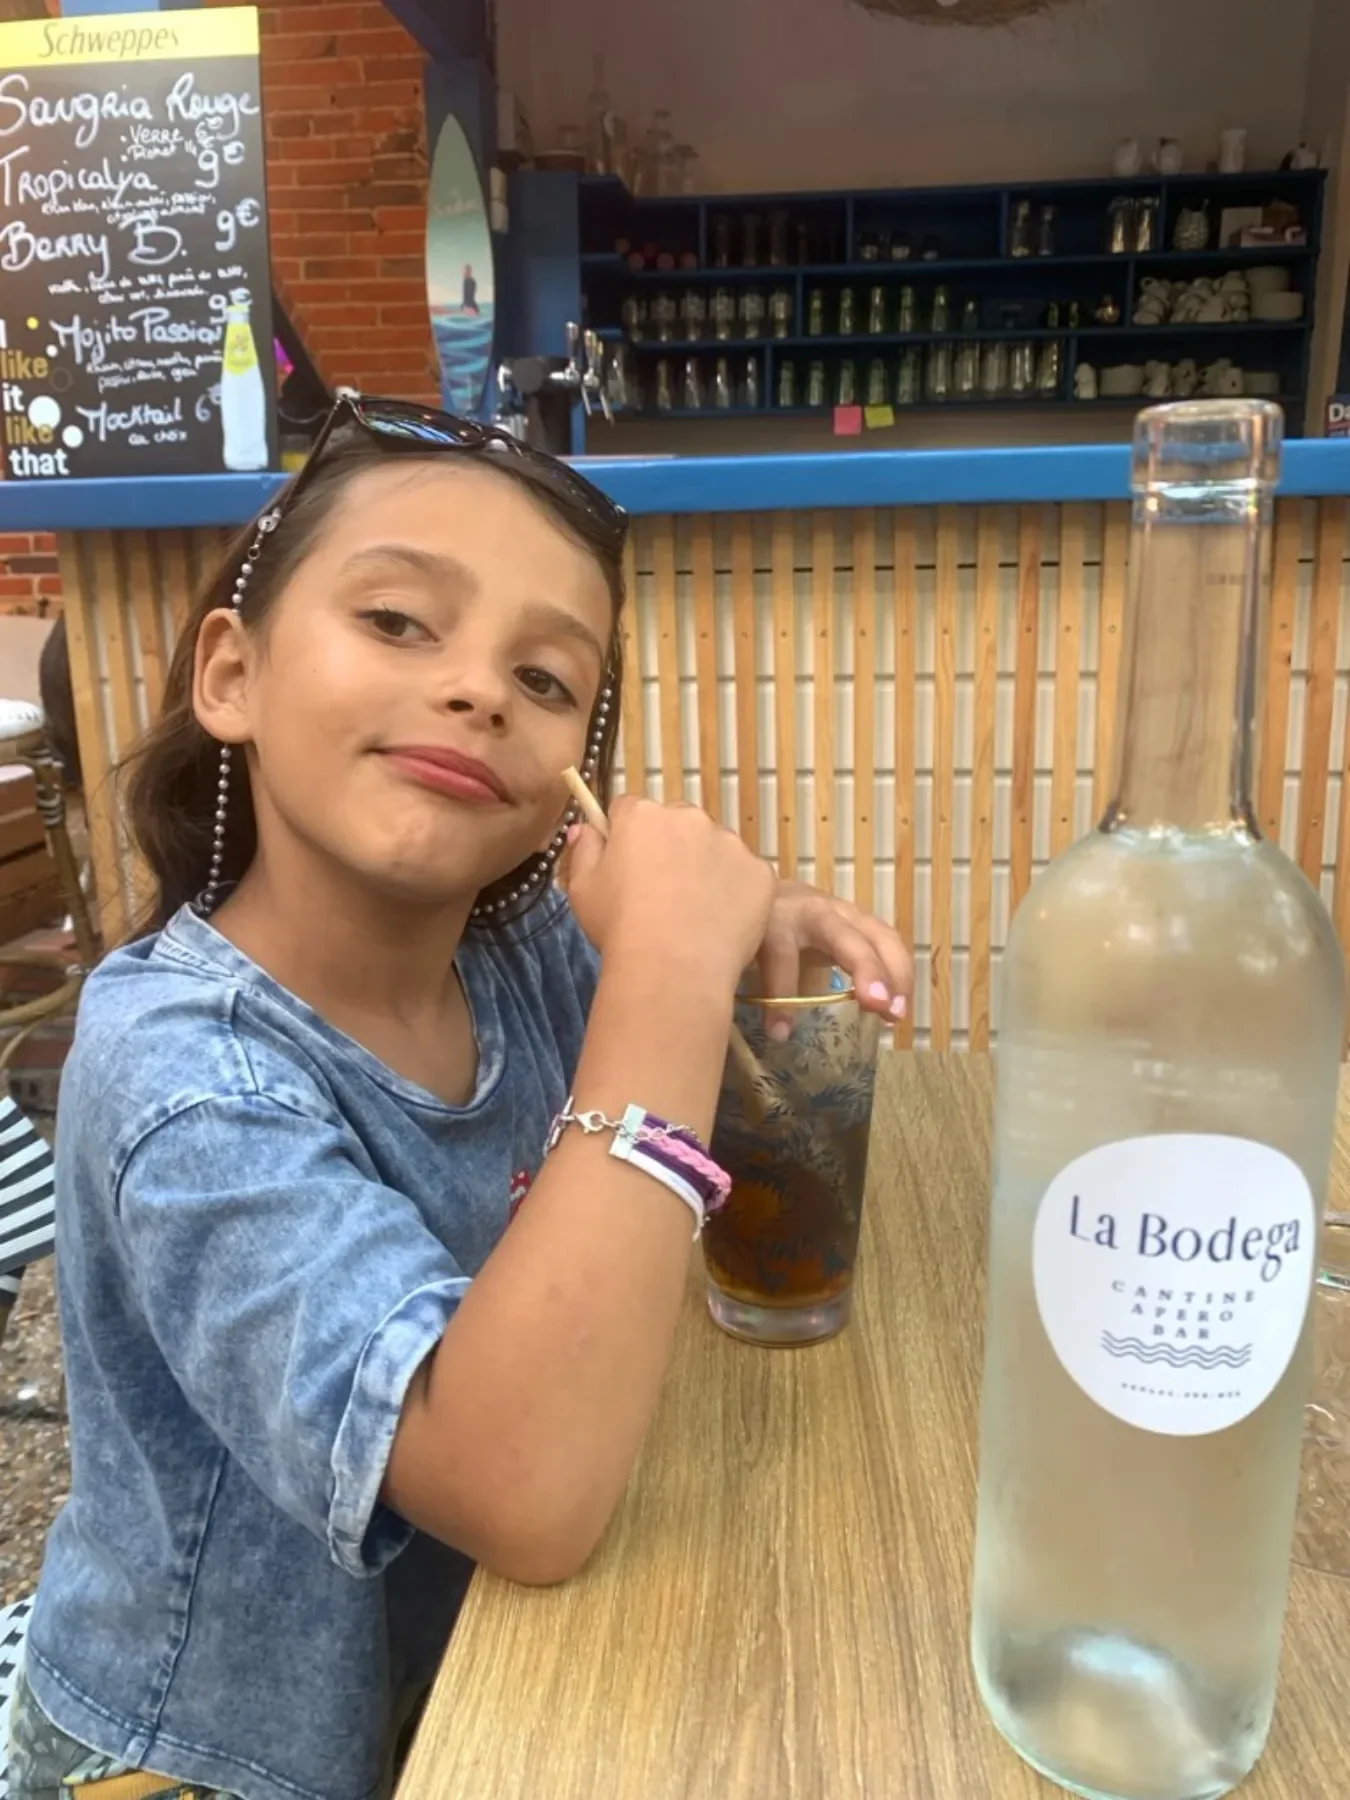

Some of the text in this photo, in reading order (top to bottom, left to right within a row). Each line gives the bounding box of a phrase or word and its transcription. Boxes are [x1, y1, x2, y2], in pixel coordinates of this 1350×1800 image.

[166, 71, 259, 139] Rouge
[214, 198, 260, 251] 9€
[49, 314, 137, 366] Mojito
[0, 349, 48, 380] like
[2, 382, 25, 412] it
[6, 415, 54, 445] like
[75, 397, 184, 442] Mocktail
[8, 446, 70, 476] that
[1070, 1194, 1301, 1283] La Bodega
[1111, 1279, 1255, 1304] CANTINE
[1152, 1323, 1209, 1340] BAR
